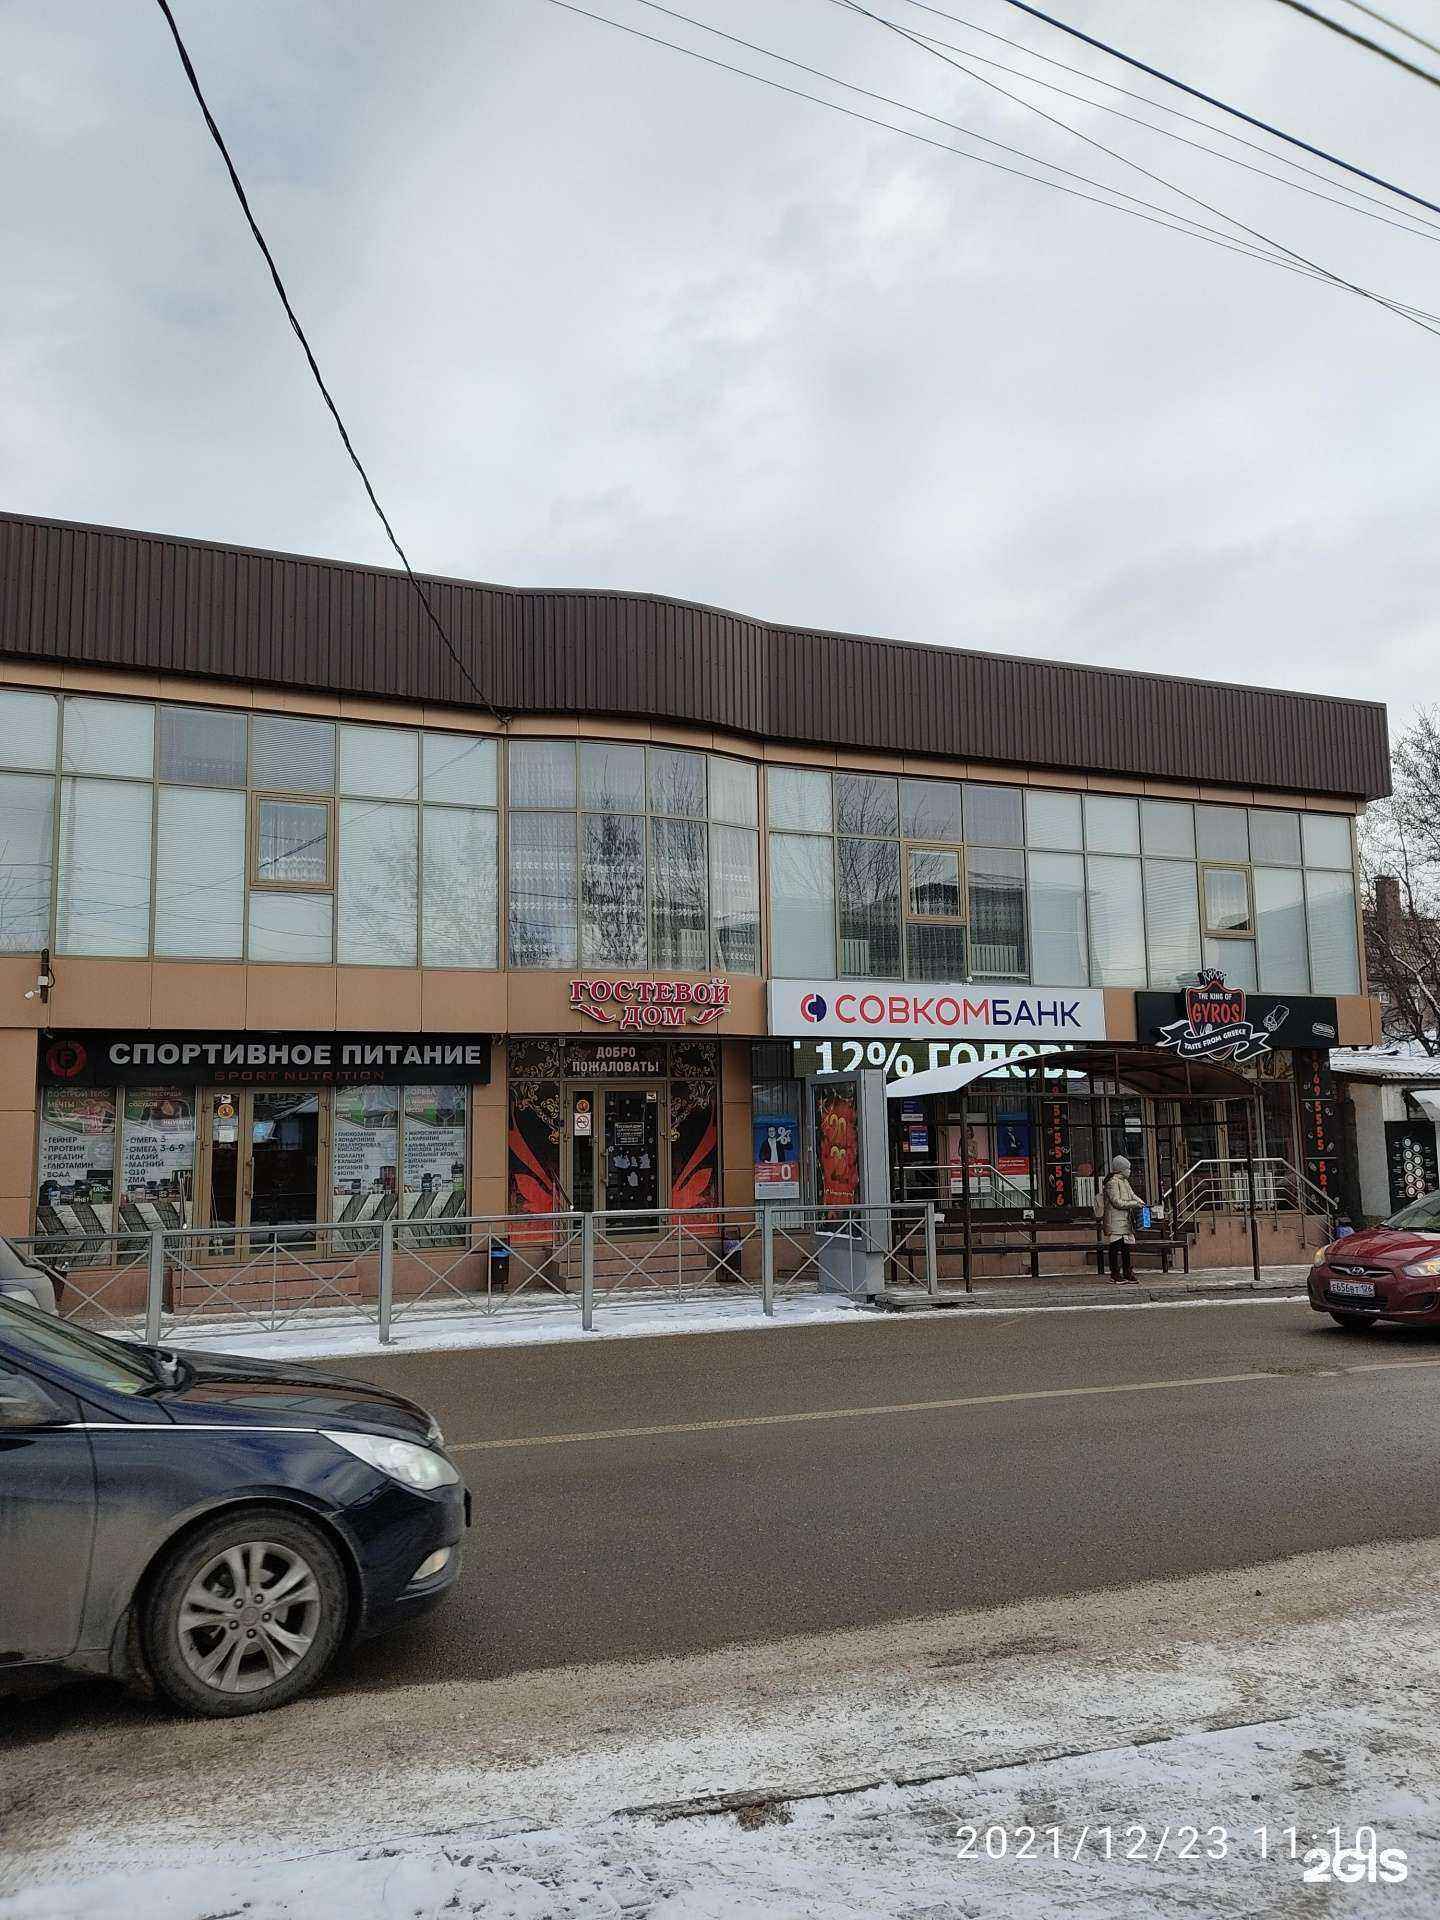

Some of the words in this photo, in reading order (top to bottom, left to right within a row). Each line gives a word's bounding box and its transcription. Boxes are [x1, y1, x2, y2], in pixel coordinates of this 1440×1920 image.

[570, 977, 731, 1004] ГОСТЕВОЙ
[620, 1005, 686, 1029] ДОМ
[835, 994, 1082, 1027] СОВКОМБАНК
[1192, 1003, 1240, 1023] GYROS
[1203, 1035, 1222, 1046] FROM
[1223, 1028, 1247, 1039] GREECE
[108, 1043, 331, 1065] СПОРТИВНОЕ
[343, 1045, 481, 1065] ПИТАНИЕ
[596, 1046, 636, 1058] ДОБРО
[815, 1041, 915, 1078] 12%
[214, 1071, 279, 1081] SPORT
[284, 1071, 384, 1081] NUTRITION
[572, 1060, 659, 1073] ПОЖАЛОВАТЬ!
